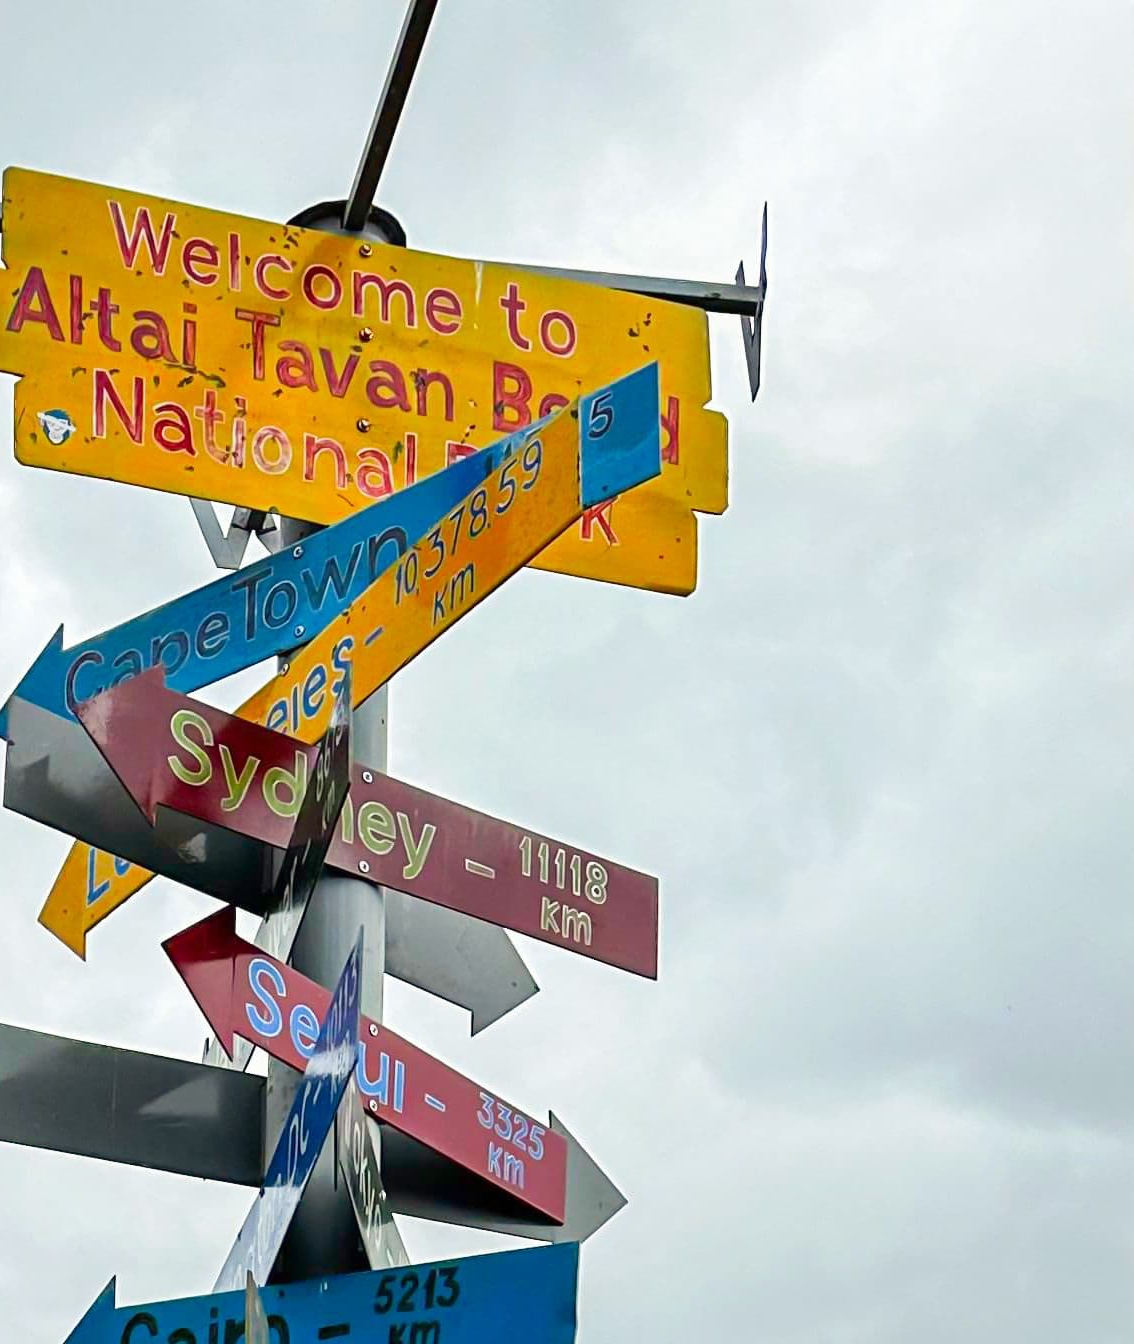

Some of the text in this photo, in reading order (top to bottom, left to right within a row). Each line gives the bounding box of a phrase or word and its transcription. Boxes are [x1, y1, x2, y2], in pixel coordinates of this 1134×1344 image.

[106, 199, 578, 358] Welcome to
[6, 266, 199, 371] Altai
[236, 308, 455, 423] Tavan
[493, 361, 680, 465] Bd
[93, 368, 418, 498] National
[65, 525, 409, 715] Cape Town
[519, 835, 610, 904] 11118
[245, 957, 406, 1115] Seul
[476, 1090, 546, 1162] 3325
[374, 1267, 462, 1314] 5213
